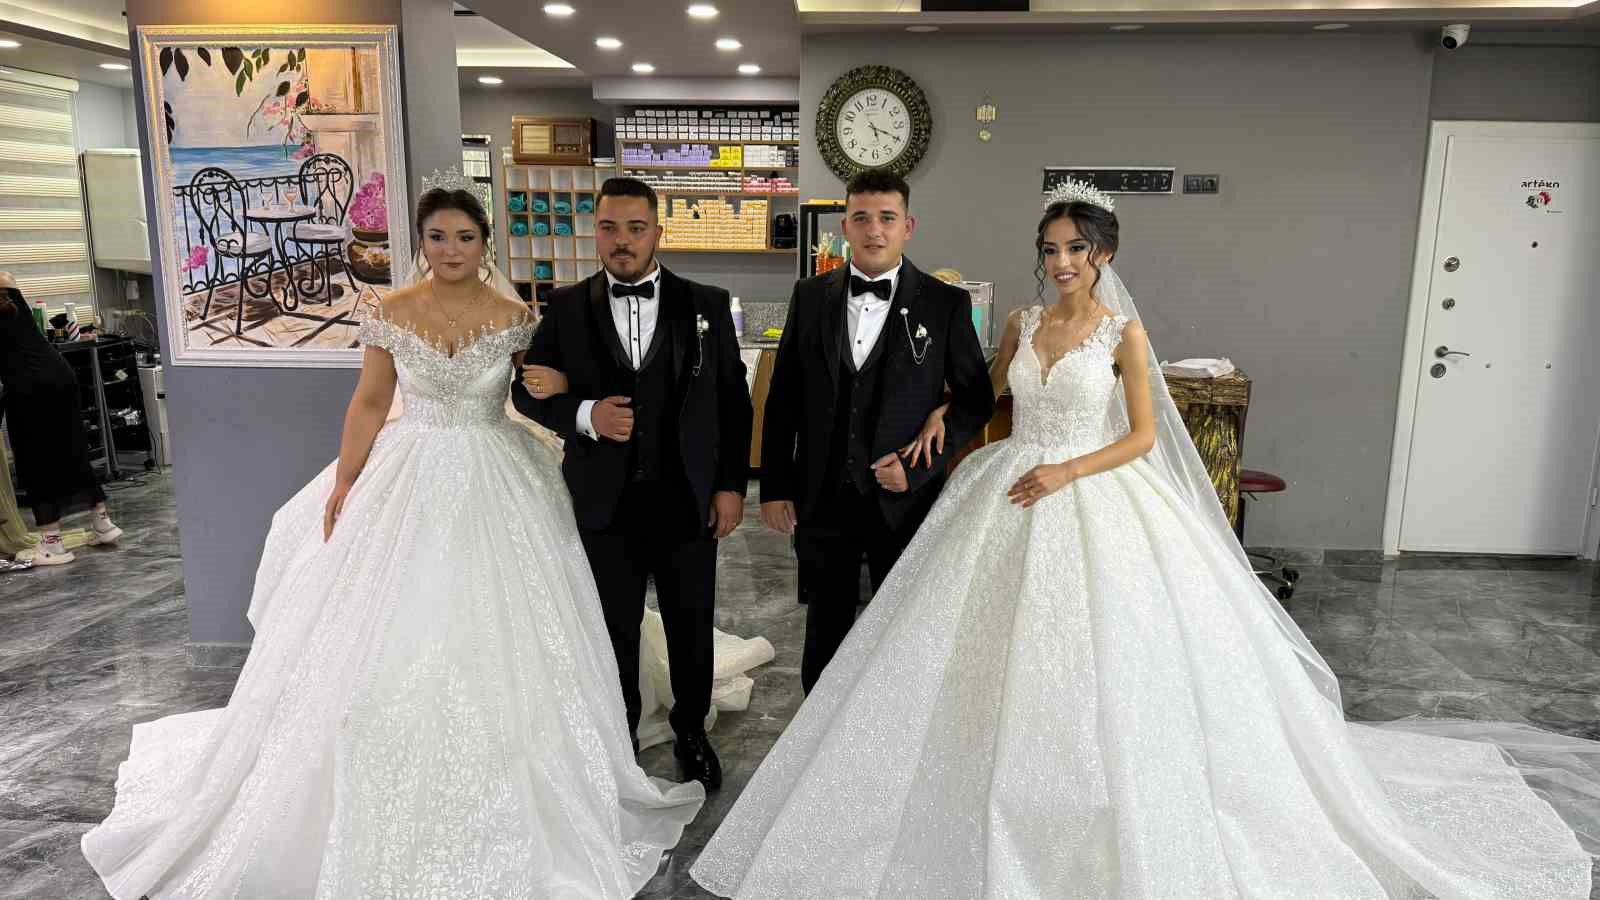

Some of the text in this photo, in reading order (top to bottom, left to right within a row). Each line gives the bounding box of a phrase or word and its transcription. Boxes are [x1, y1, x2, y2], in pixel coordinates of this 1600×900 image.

[866, 94, 877, 106] 12
[882, 97, 887, 109] 1
[854, 101, 864, 112] 11
[889, 106, 900, 117] 2
[844, 111, 856, 122] 10
[894, 120, 904, 129] 3
[843, 127, 853, 136] 9
[848, 139, 857, 149] 8
[883, 144, 893, 155] 5
[859, 147, 867, 158] 7
[872, 149, 879, 159] 6
